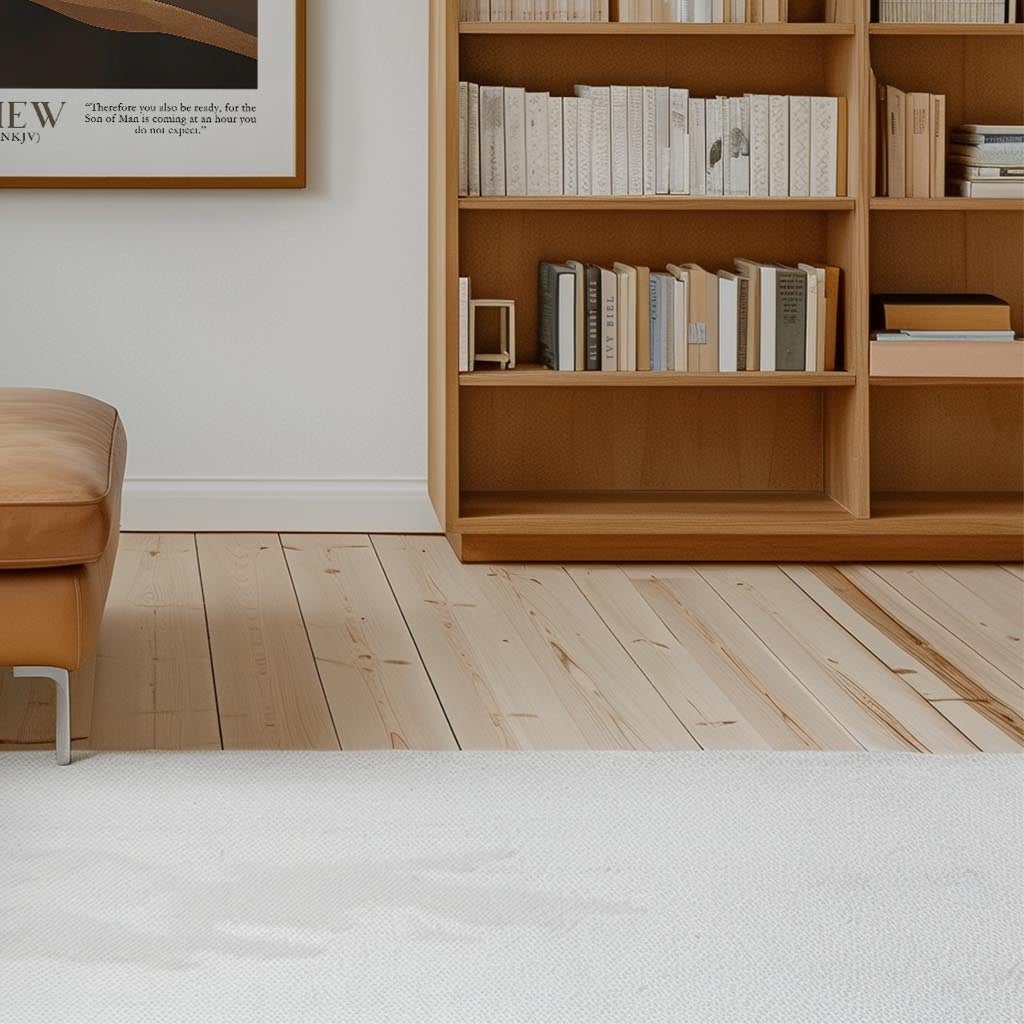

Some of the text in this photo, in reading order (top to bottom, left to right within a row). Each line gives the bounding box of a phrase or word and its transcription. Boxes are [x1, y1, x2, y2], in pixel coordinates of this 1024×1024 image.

[139, 104, 157, 114] you
[159, 102, 178, 112] also
[180, 102, 192, 112] be
[225, 102, 240, 112] for
[241, 102, 257, 112] the
[84, 113, 257, 125] Son of Man is coming at an hour you
[134, 125, 147, 134] do
[149, 125, 165, 134] not
[589, 309, 597, 338] ABOUT
[605, 295, 615, 360] IVY BIEL
[589, 343, 597, 361] ALL
